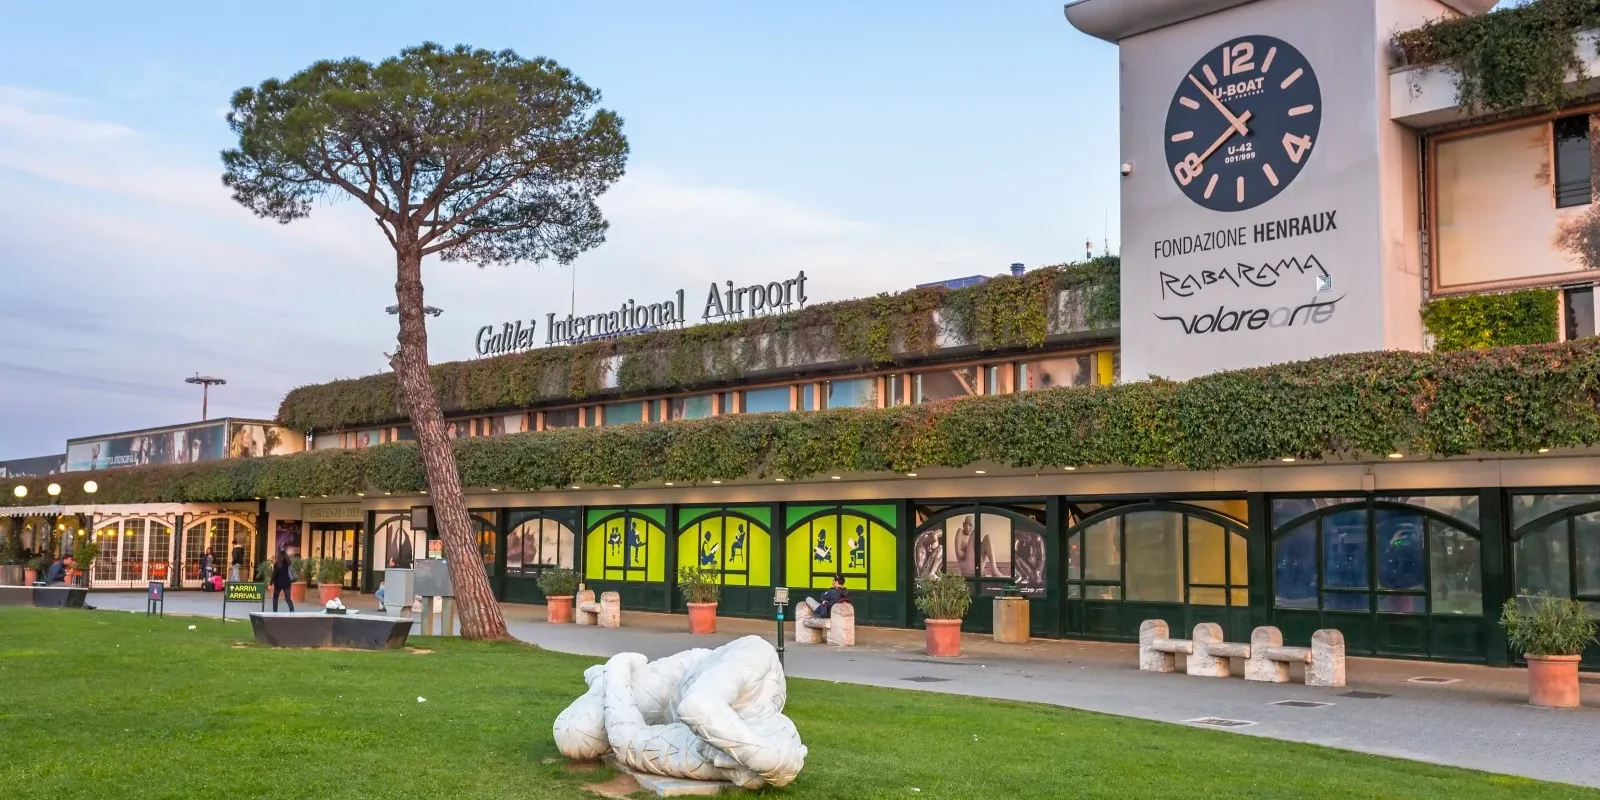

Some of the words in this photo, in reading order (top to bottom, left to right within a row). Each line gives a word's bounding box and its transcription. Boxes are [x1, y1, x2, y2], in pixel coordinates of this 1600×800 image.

[1222, 41, 1255, 77] 12
[1212, 77, 1265, 99] U-BOAT
[1224, 151, 1256, 164] 001/999
[1227, 142, 1253, 155] U-42
[1282, 132, 1312, 163] 4
[1154, 226, 1247, 259] FONDAZIONE
[1253, 210, 1337, 243] HENRAUX
[1160, 254, 1329, 300] RABARAMA
[475, 319, 536, 356] Galilei
[545, 288, 685, 345] International
[702, 270, 808, 319] Airport
[1153, 293, 1348, 334] volarearte
[229, 592, 261, 600] ARRIVALS
